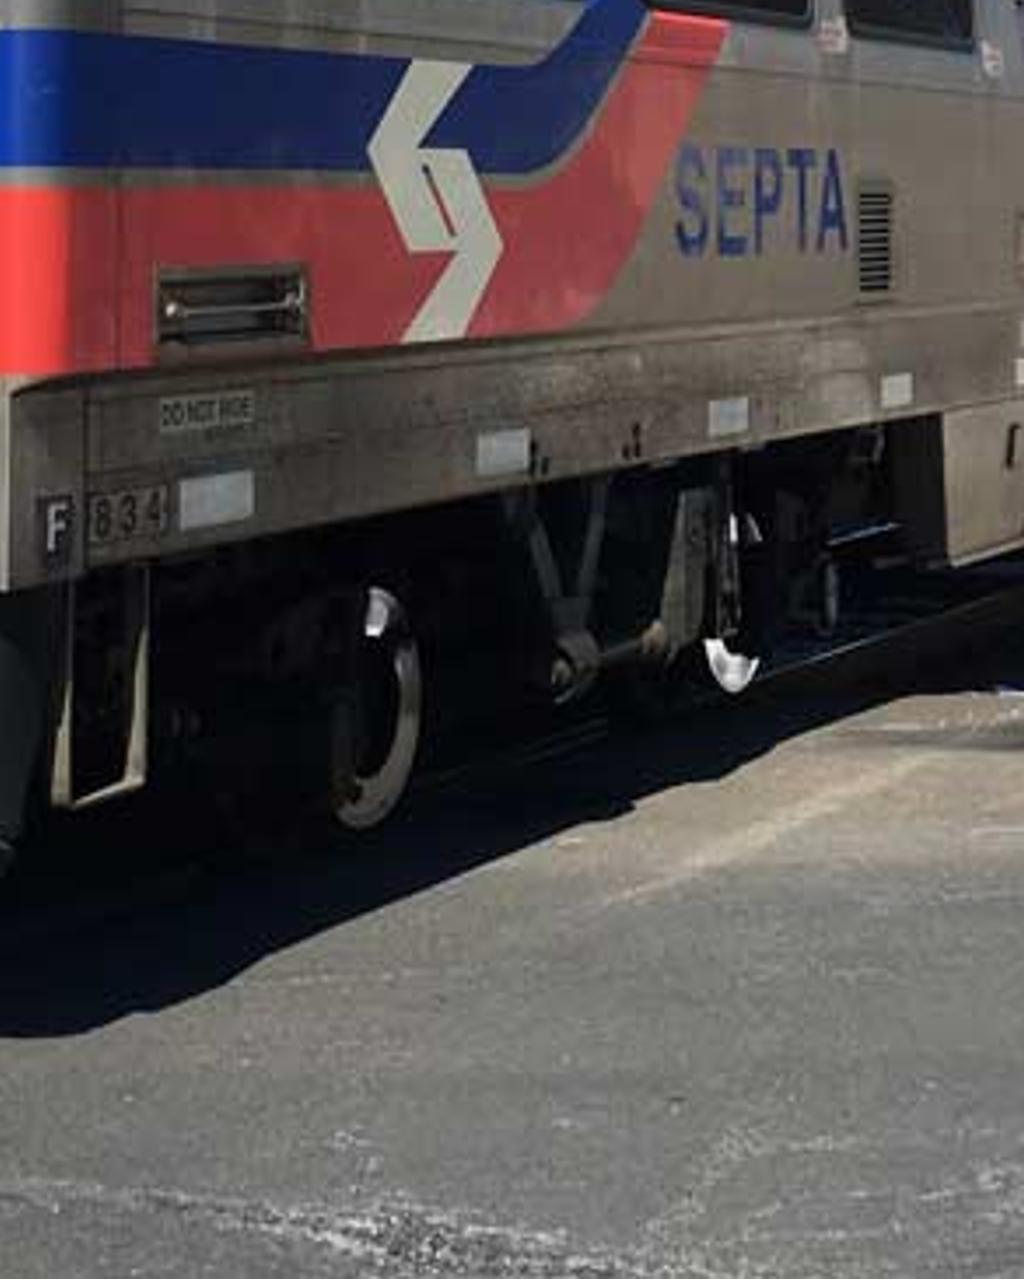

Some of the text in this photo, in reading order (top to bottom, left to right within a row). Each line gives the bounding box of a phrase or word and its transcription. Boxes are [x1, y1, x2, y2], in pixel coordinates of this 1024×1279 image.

[675, 146, 848, 258] SEPTA
[187, 399, 218, 423] NOT
[47, 502, 69, 552] F
[94, 490, 163, 541] 834
